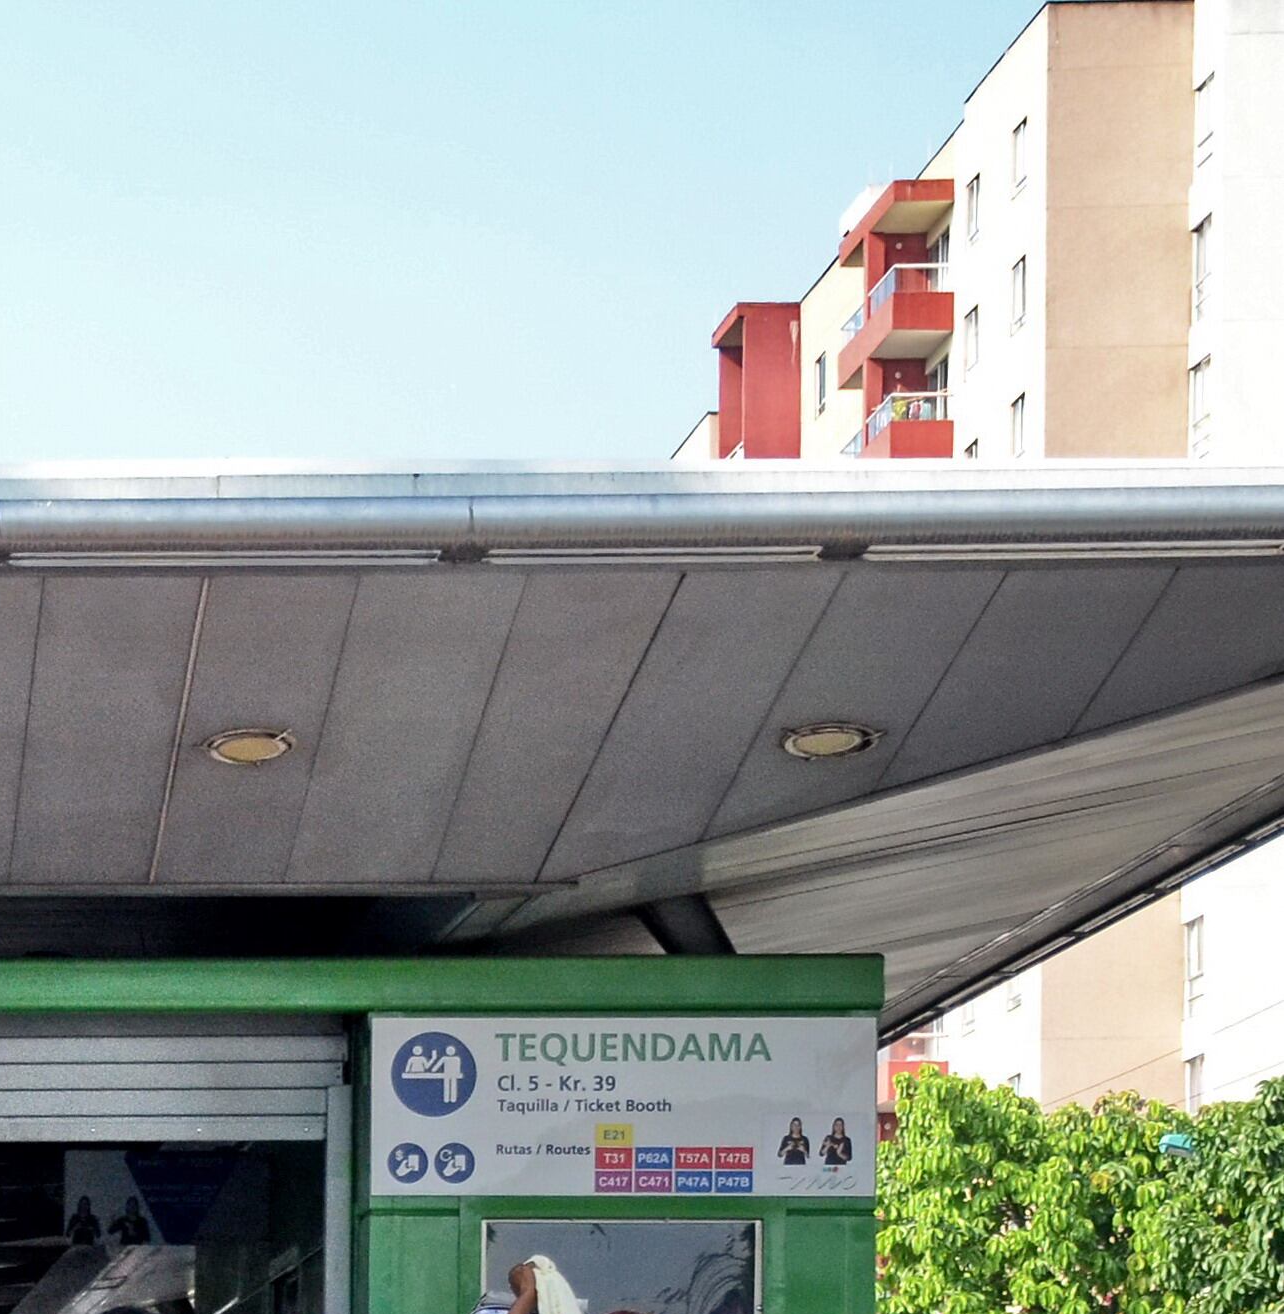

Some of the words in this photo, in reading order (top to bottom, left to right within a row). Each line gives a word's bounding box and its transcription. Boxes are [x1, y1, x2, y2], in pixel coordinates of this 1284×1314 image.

[494, 1032, 773, 1066] TEQUENDAMA
[497, 1075, 522, 1092] Cl.
[528, 1076, 539, 1092] 5
[559, 1075, 586, 1092] Kr.
[592, 1075, 617, 1092] 39
[497, 1098, 559, 1115] Taquilla
[563, 1098, 570, 1113] /
[574, 1098, 621, 1113] Ticket
[625, 1098, 672, 1113] Booth
[603, 1129, 625, 1141] E21
[496, 1144, 532, 1156] Rutas
[545, 1144, 591, 1156] Routes
[603, 1152, 626, 1164] T31
[718, 1153, 751, 1164] T47B
[598, 1176, 629, 1187] C417
[638, 1175, 670, 1188] C471
[677, 1176, 710, 1188] P47A
[717, 1176, 750, 1188] P47B
